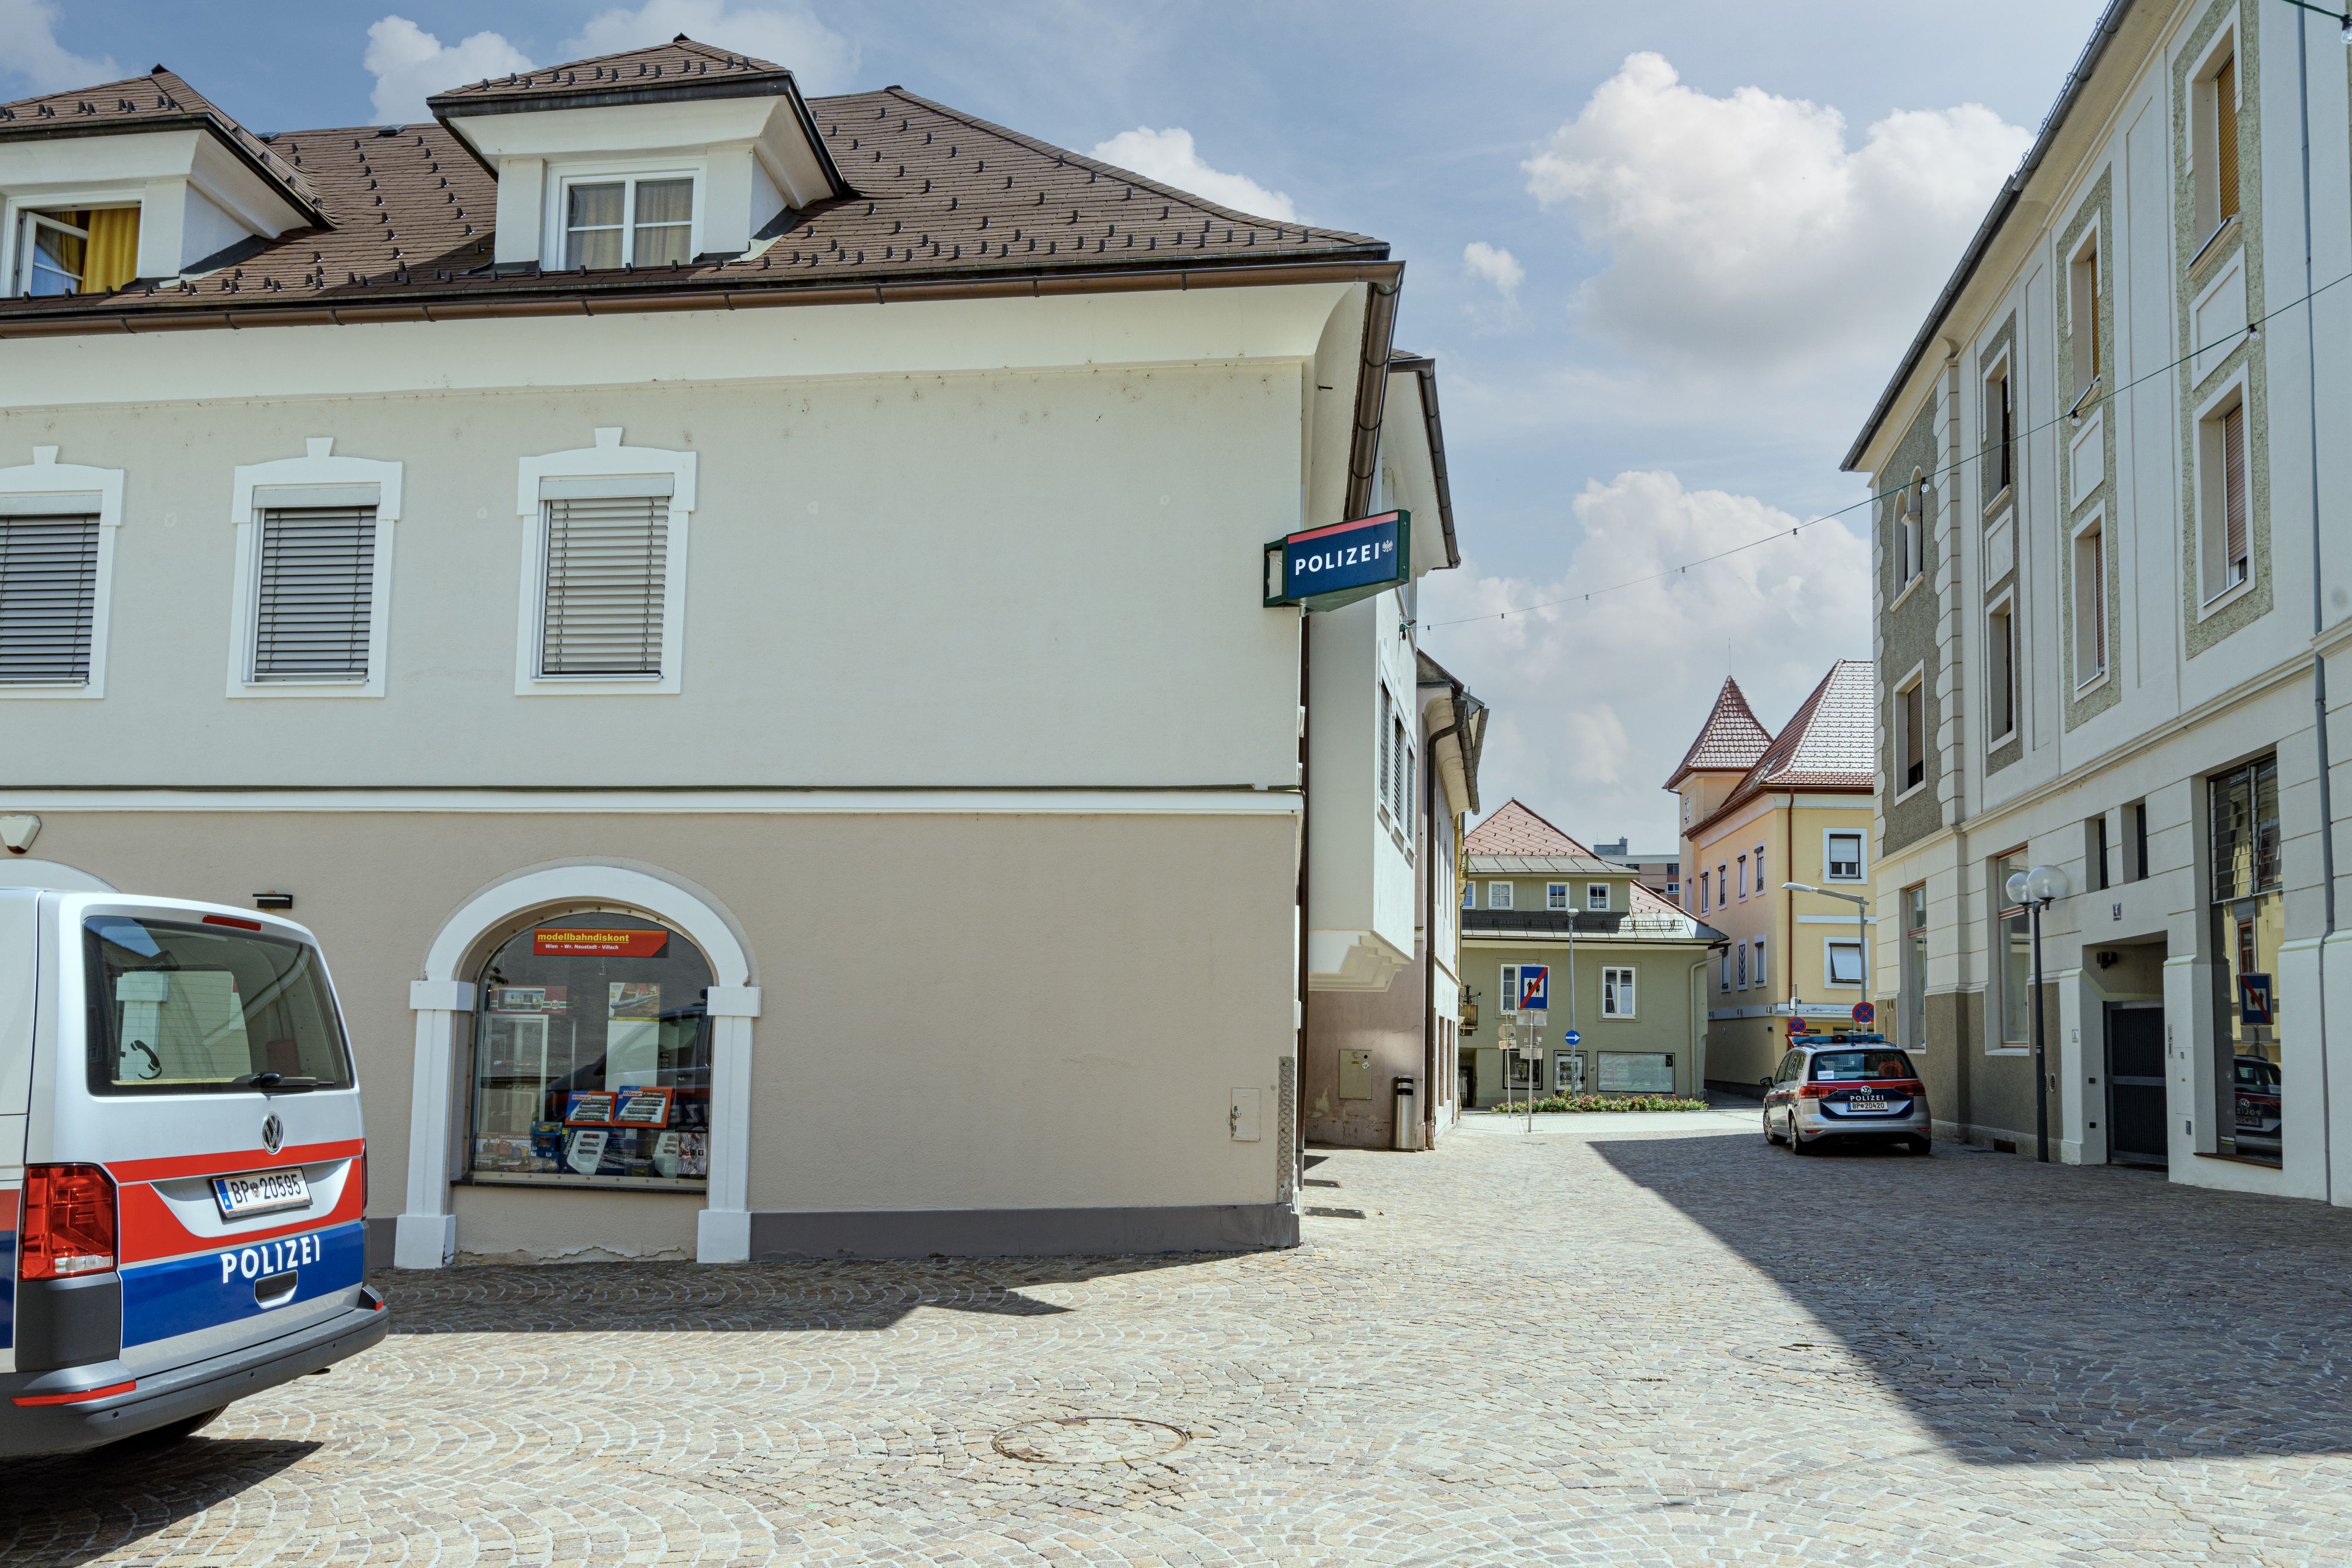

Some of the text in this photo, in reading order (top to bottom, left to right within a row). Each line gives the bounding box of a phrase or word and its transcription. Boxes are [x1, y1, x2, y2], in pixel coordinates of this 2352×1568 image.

[1295, 542, 1379, 576] POLIZEI
[537, 932, 629, 942] modellbahndiskont
[563, 1132, 575, 1155] Digitalset
[224, 1174, 301, 1206] A BP 20595
[220, 1235, 320, 1284] POLIZEI
